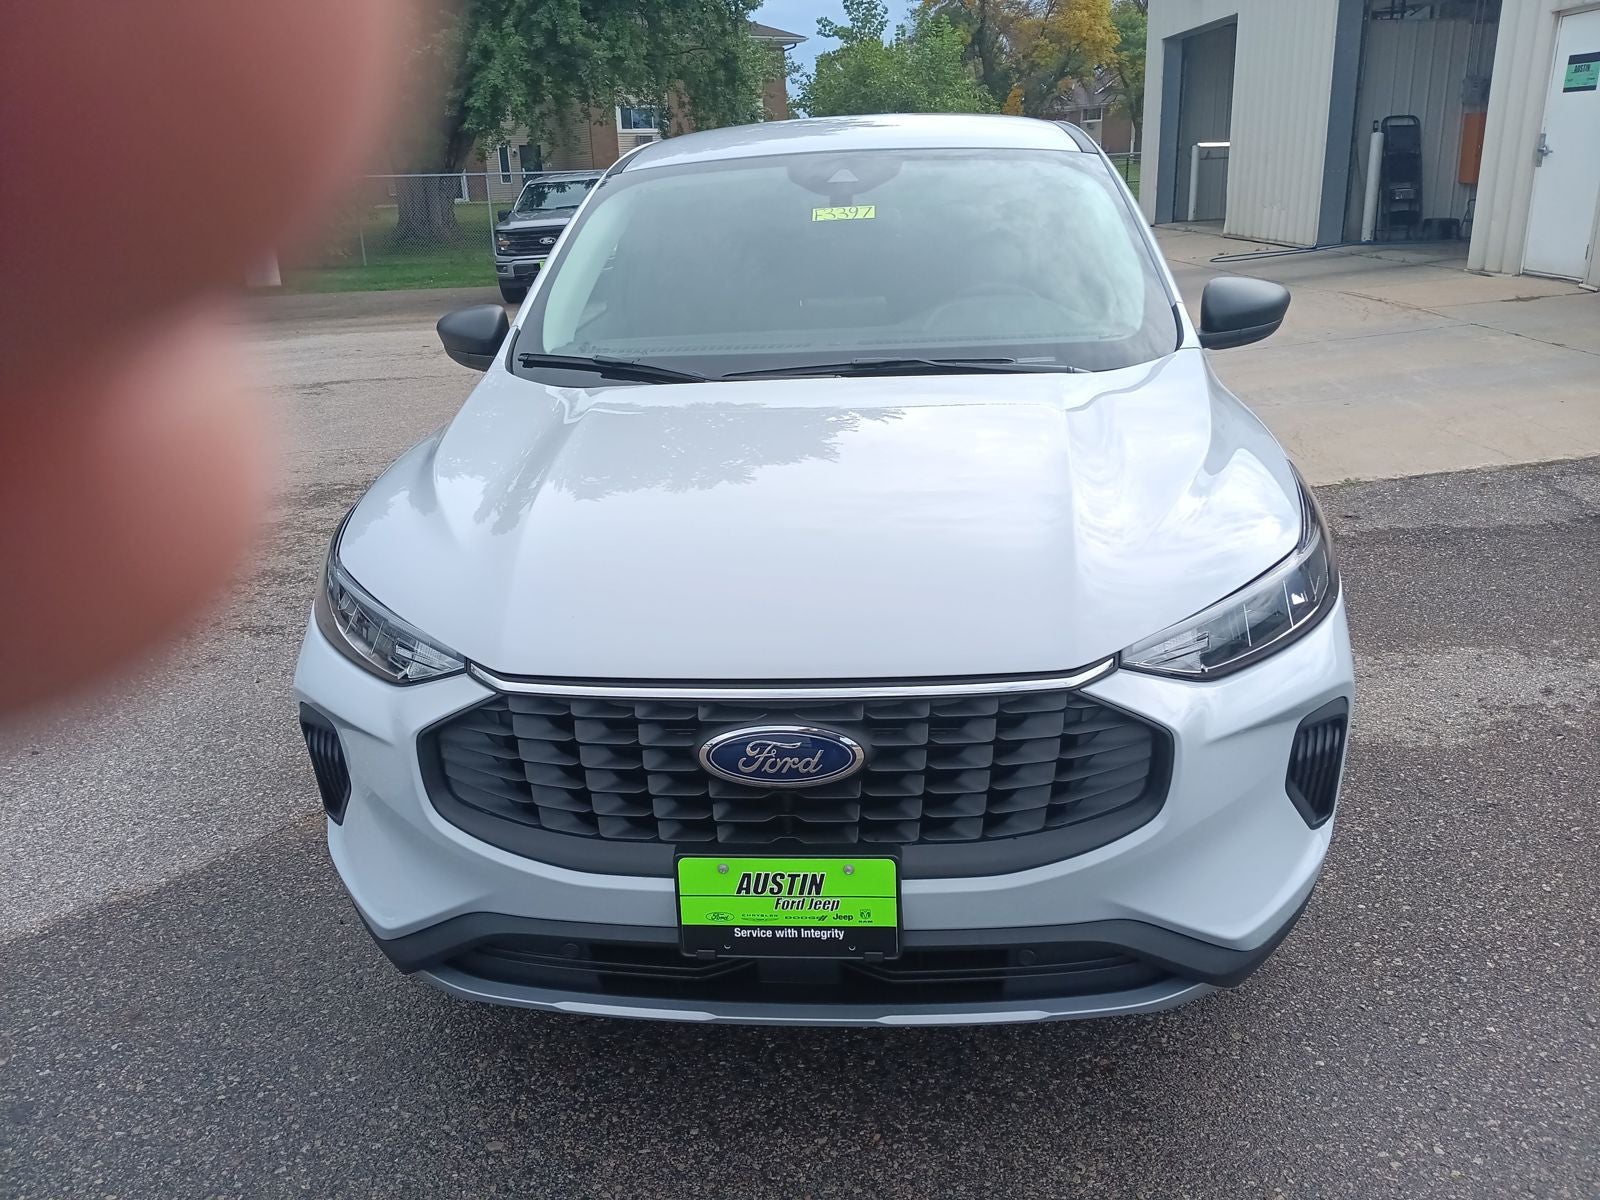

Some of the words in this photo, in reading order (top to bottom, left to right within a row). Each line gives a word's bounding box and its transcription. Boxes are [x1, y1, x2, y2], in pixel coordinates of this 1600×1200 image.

[737, 740, 825, 774] Ford
[735, 871, 826, 896] AUSTIN
[774, 896, 804, 911] Ford
[807, 897, 841, 912] Jeep
[832, 913, 854, 921] Jeep
[734, 927, 773, 938] Service
[775, 927, 798, 938] with
[800, 928, 845, 940] Integrity
